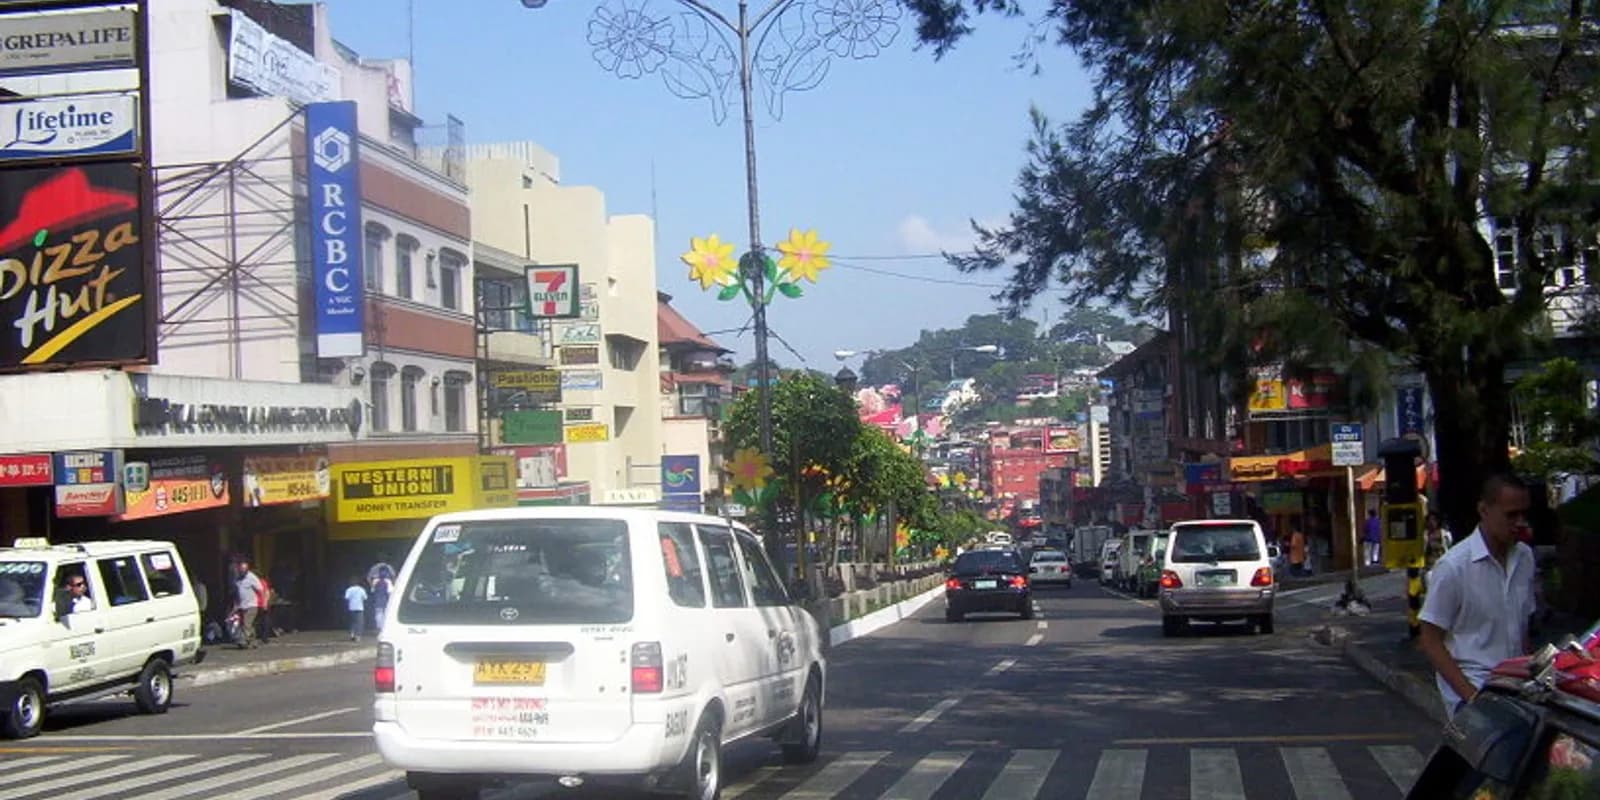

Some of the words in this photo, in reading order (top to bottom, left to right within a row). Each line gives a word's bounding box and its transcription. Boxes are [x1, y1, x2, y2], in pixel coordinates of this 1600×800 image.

[4, 26, 130, 50] GREPALIFE
[4, 104, 113, 148] Lifetime
[322, 184, 350, 293] RCBC
[533, 270, 566, 315] 7
[13, 265, 126, 349] Hut
[497, 372, 558, 385] Pastiche
[344, 468, 433, 485] WESTERN
[373, 481, 433, 496] UNION
[356, 501, 392, 513] MONEY
[396, 500, 447, 511] TRANSFER
